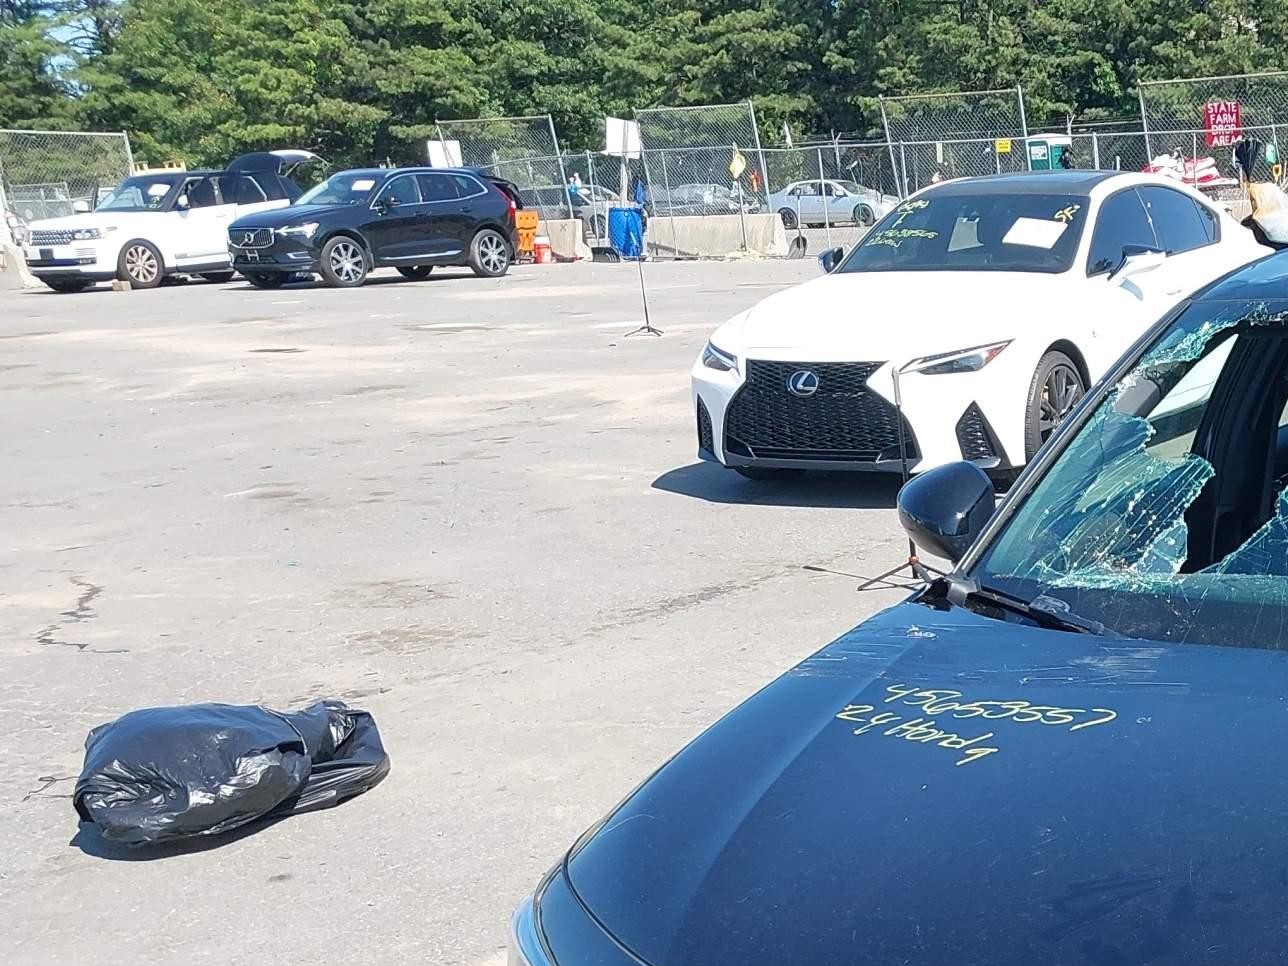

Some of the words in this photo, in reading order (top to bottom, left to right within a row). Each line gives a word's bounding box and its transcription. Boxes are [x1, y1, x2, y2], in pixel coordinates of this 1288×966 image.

[1207, 102, 1238, 113] STATE
[1210, 113, 1237, 125] FARM
[1212, 134, 1243, 147] AREA
